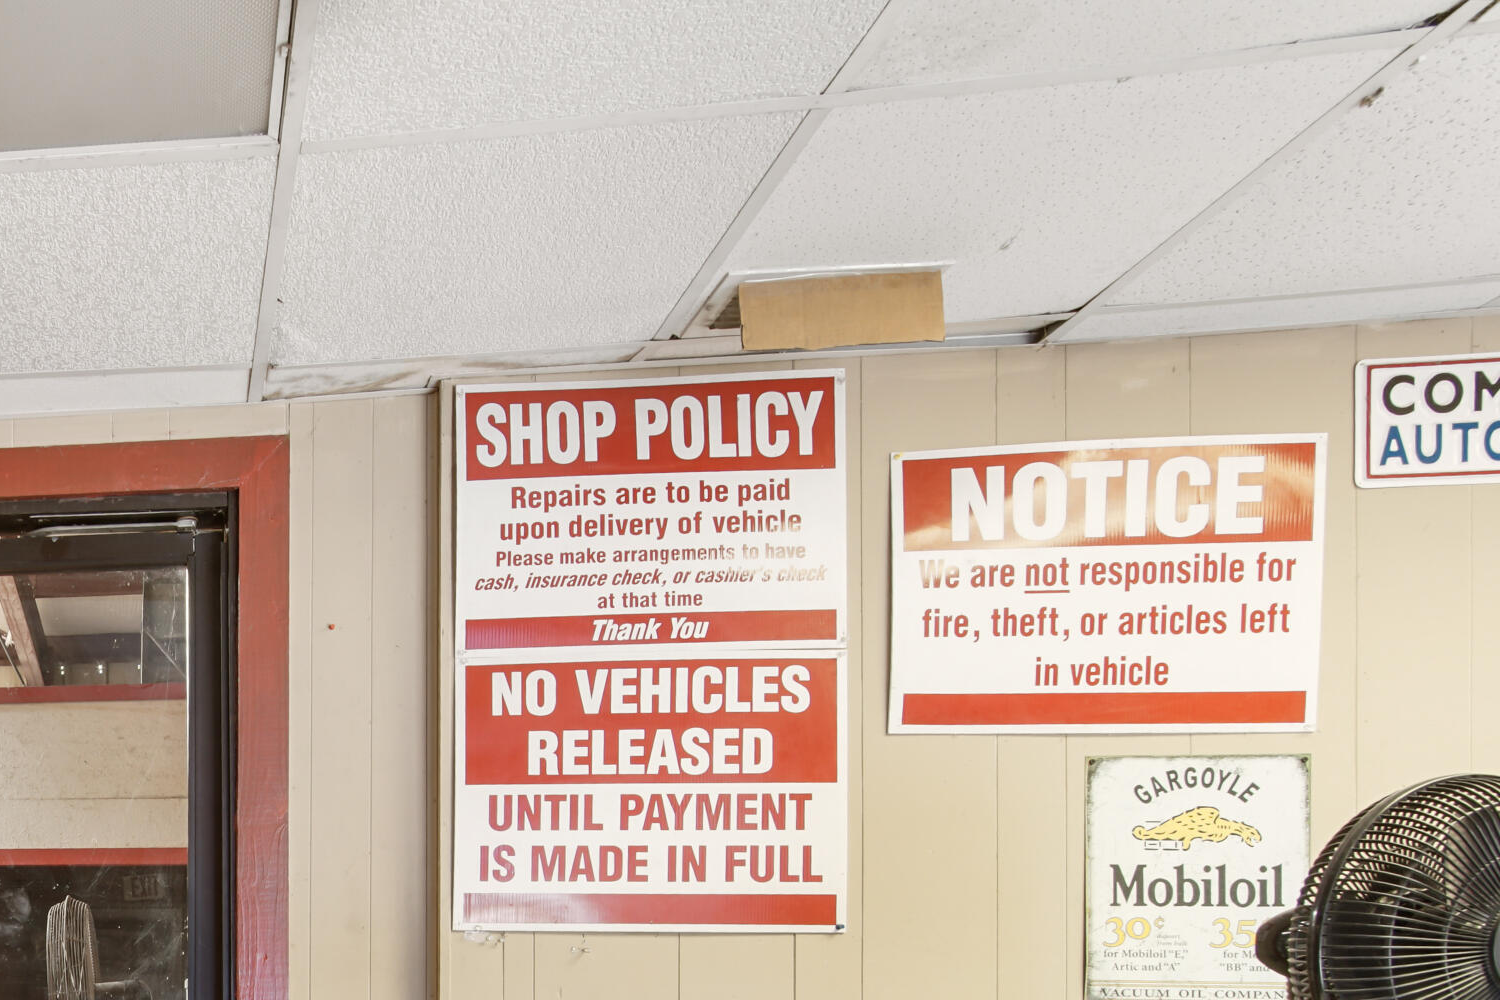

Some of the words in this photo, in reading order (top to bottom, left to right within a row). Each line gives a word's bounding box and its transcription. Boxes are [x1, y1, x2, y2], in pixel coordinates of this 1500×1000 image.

[476, 400, 616, 468] SHOP
[635, 390, 824, 460] POLICY
[511, 485, 606, 512] Repairs
[616, 483, 656, 505] are
[666, 480, 689, 502] to
[699, 479, 729, 502] be
[737, 478, 791, 506] paid
[950, 454, 1266, 543] NOTICE
[500, 518, 560, 544] upon
[568, 513, 668, 540] delivery
[678, 512, 703, 535] of
[713, 509, 802, 534] vehicle
[496, 551, 553, 567] Please
[560, 550, 606, 564] make
[612, 545, 734, 565] arrangements
[743, 545, 759, 560] to
[764, 543, 806, 559] have
[918, 558, 960, 589] We
[970, 561, 1015, 588] are
[1024, 557, 1070, 589] not
[1079, 552, 1245, 592] responsible
[1256, 552, 1297, 582] for
[475, 574, 519, 593] cash,
[526, 572, 607, 589] insurance
[611, 570, 667, 588] check,
[673, 571, 690, 584] or
[695, 566, 771, 584] cashier's
[777, 563, 827, 582] check
[597, 593, 615, 609] at
[622, 592, 658, 608] that
[664, 590, 703, 607] time
[591, 619, 661, 642] Thank
[670, 617, 709, 640] You
[922, 607, 981, 644] fire,
[991, 604, 1070, 641] theft,
[1081, 610, 1108, 636] or
[1118, 603, 1227, 636] articles
[1240, 601, 1291, 634] left
[1035, 656, 1060, 687] in
[1070, 654, 1170, 687] vehicle
[491, 670, 558, 717] NO
[576, 665, 811, 715] VEHICLES
[527, 727, 773, 777] RELEASED
[1133, 766, 1261, 804] GARGOYLE
[488, 794, 604, 832] UNTIL
[620, 792, 813, 831] PAYMENT
[479, 844, 516, 883] IS
[530, 845, 650, 883] MADE
[666, 845, 708, 883] IN
[724, 845, 823, 883] FULL
[1110, 863, 1285, 908] Mobiloil
[1103, 949, 1119, 958] for
[1122, 949, 1166, 959] Mobiloil
[1112, 962, 1140, 971] Artic
[1141, 962, 1162, 971] and
[1223, 949, 1239, 959] for
[1100, 987, 1170, 999] VACUUM
[1179, 988, 1204, 999] OIL
[1214, 988, 1287, 1000] COMPAN
